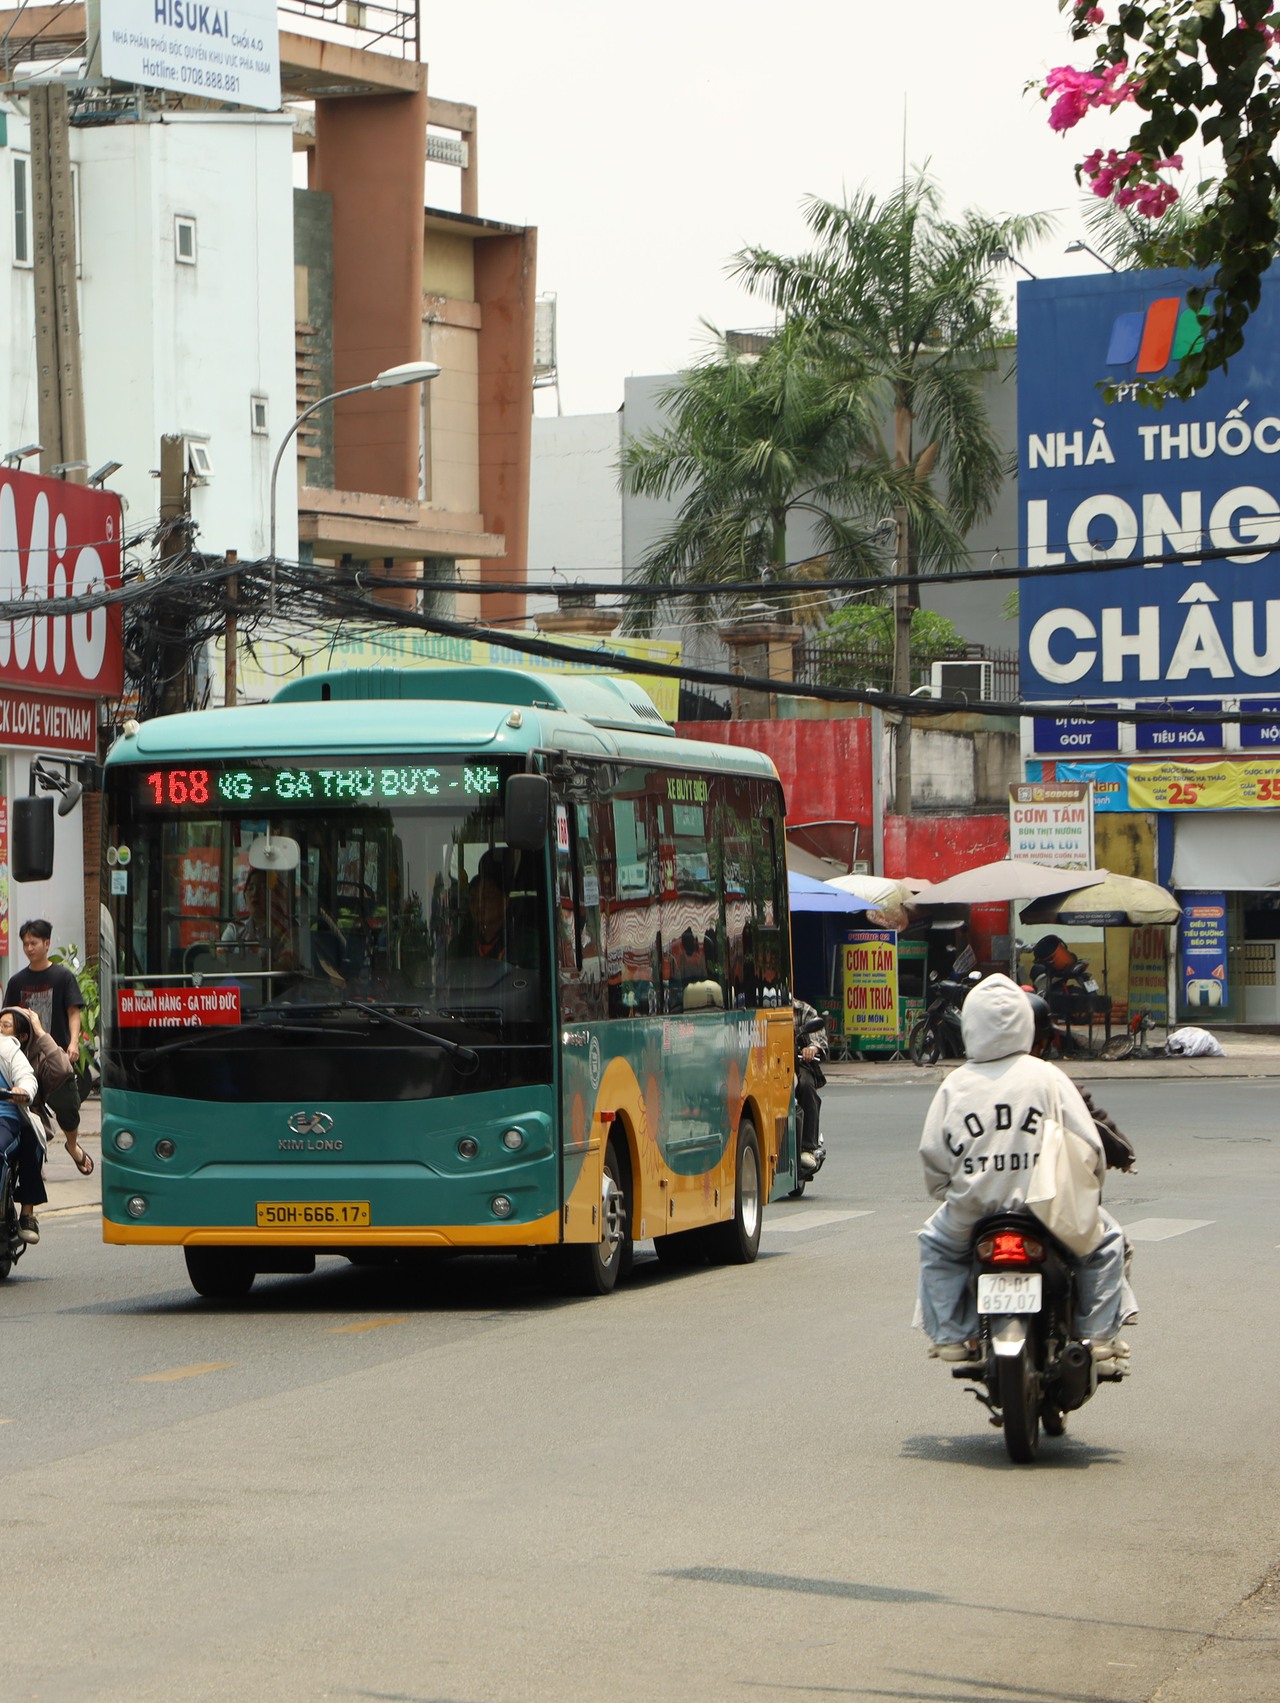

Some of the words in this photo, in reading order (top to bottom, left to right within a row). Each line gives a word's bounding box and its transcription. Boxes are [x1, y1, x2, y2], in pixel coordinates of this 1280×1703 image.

[154, 0, 230, 38] HISUKAI
[112, 30, 129, 46] NHÀ
[129, 33, 150, 49] PHÂN
[208, 49, 224, 65] KHU
[254, 61, 271, 74] NAM
[250, 38, 264, 52] 4.0
[142, 58, 179, 81] Hotline:
[180, 66, 241, 93] 0708.888.881
[1027, 418, 1116, 469] NHÀ
[1138, 399, 1280, 462] THUỐC
[1027, 486, 1280, 570] LONG
[1027, 581, 1280, 684] CHÂU
[12, 701, 42, 737] LOVE
[43, 705, 92, 741] VIETNAM
[1059, 734, 1093, 745] GOUT
[1152, 729, 1176, 744] TIÊU
[1178, 728, 1206, 742] HÓA
[148, 769, 210, 804] 168
[275, 771, 314, 798] GA
[666, 776, 677, 800] XE
[676, 774, 693, 801] BUÝT
[1013, 808, 1048, 823] CƠM
[1053, 804, 1085, 823] TẤM
[557, 817, 567, 845] 168
[1018, 827, 1035, 836] BÚN
[1036, 827, 1053, 837] THỊT
[1055, 826, 1082, 835] NƯỚNG
[846, 948, 869, 971] CƠM
[871, 943, 893, 971] TẤM
[121, 997, 134, 1012] ĐH
[159, 993, 182, 1011] HÀNG
[187, 997, 200, 1011] GA
[200, 990, 218, 1010] THỦ
[219, 992, 238, 1010] ĐỨC
[846, 985, 868, 1010] CƠM
[869, 985, 894, 1010] TRƯA
[946, 1103, 1044, 1158] CODE
[278, 1139, 305, 1151] KIM
[307, 1139, 343, 1151] LONG
[265, 1206, 360, 1224] 50H-666.17
[983, 1294, 1037, 1311] 857.07
